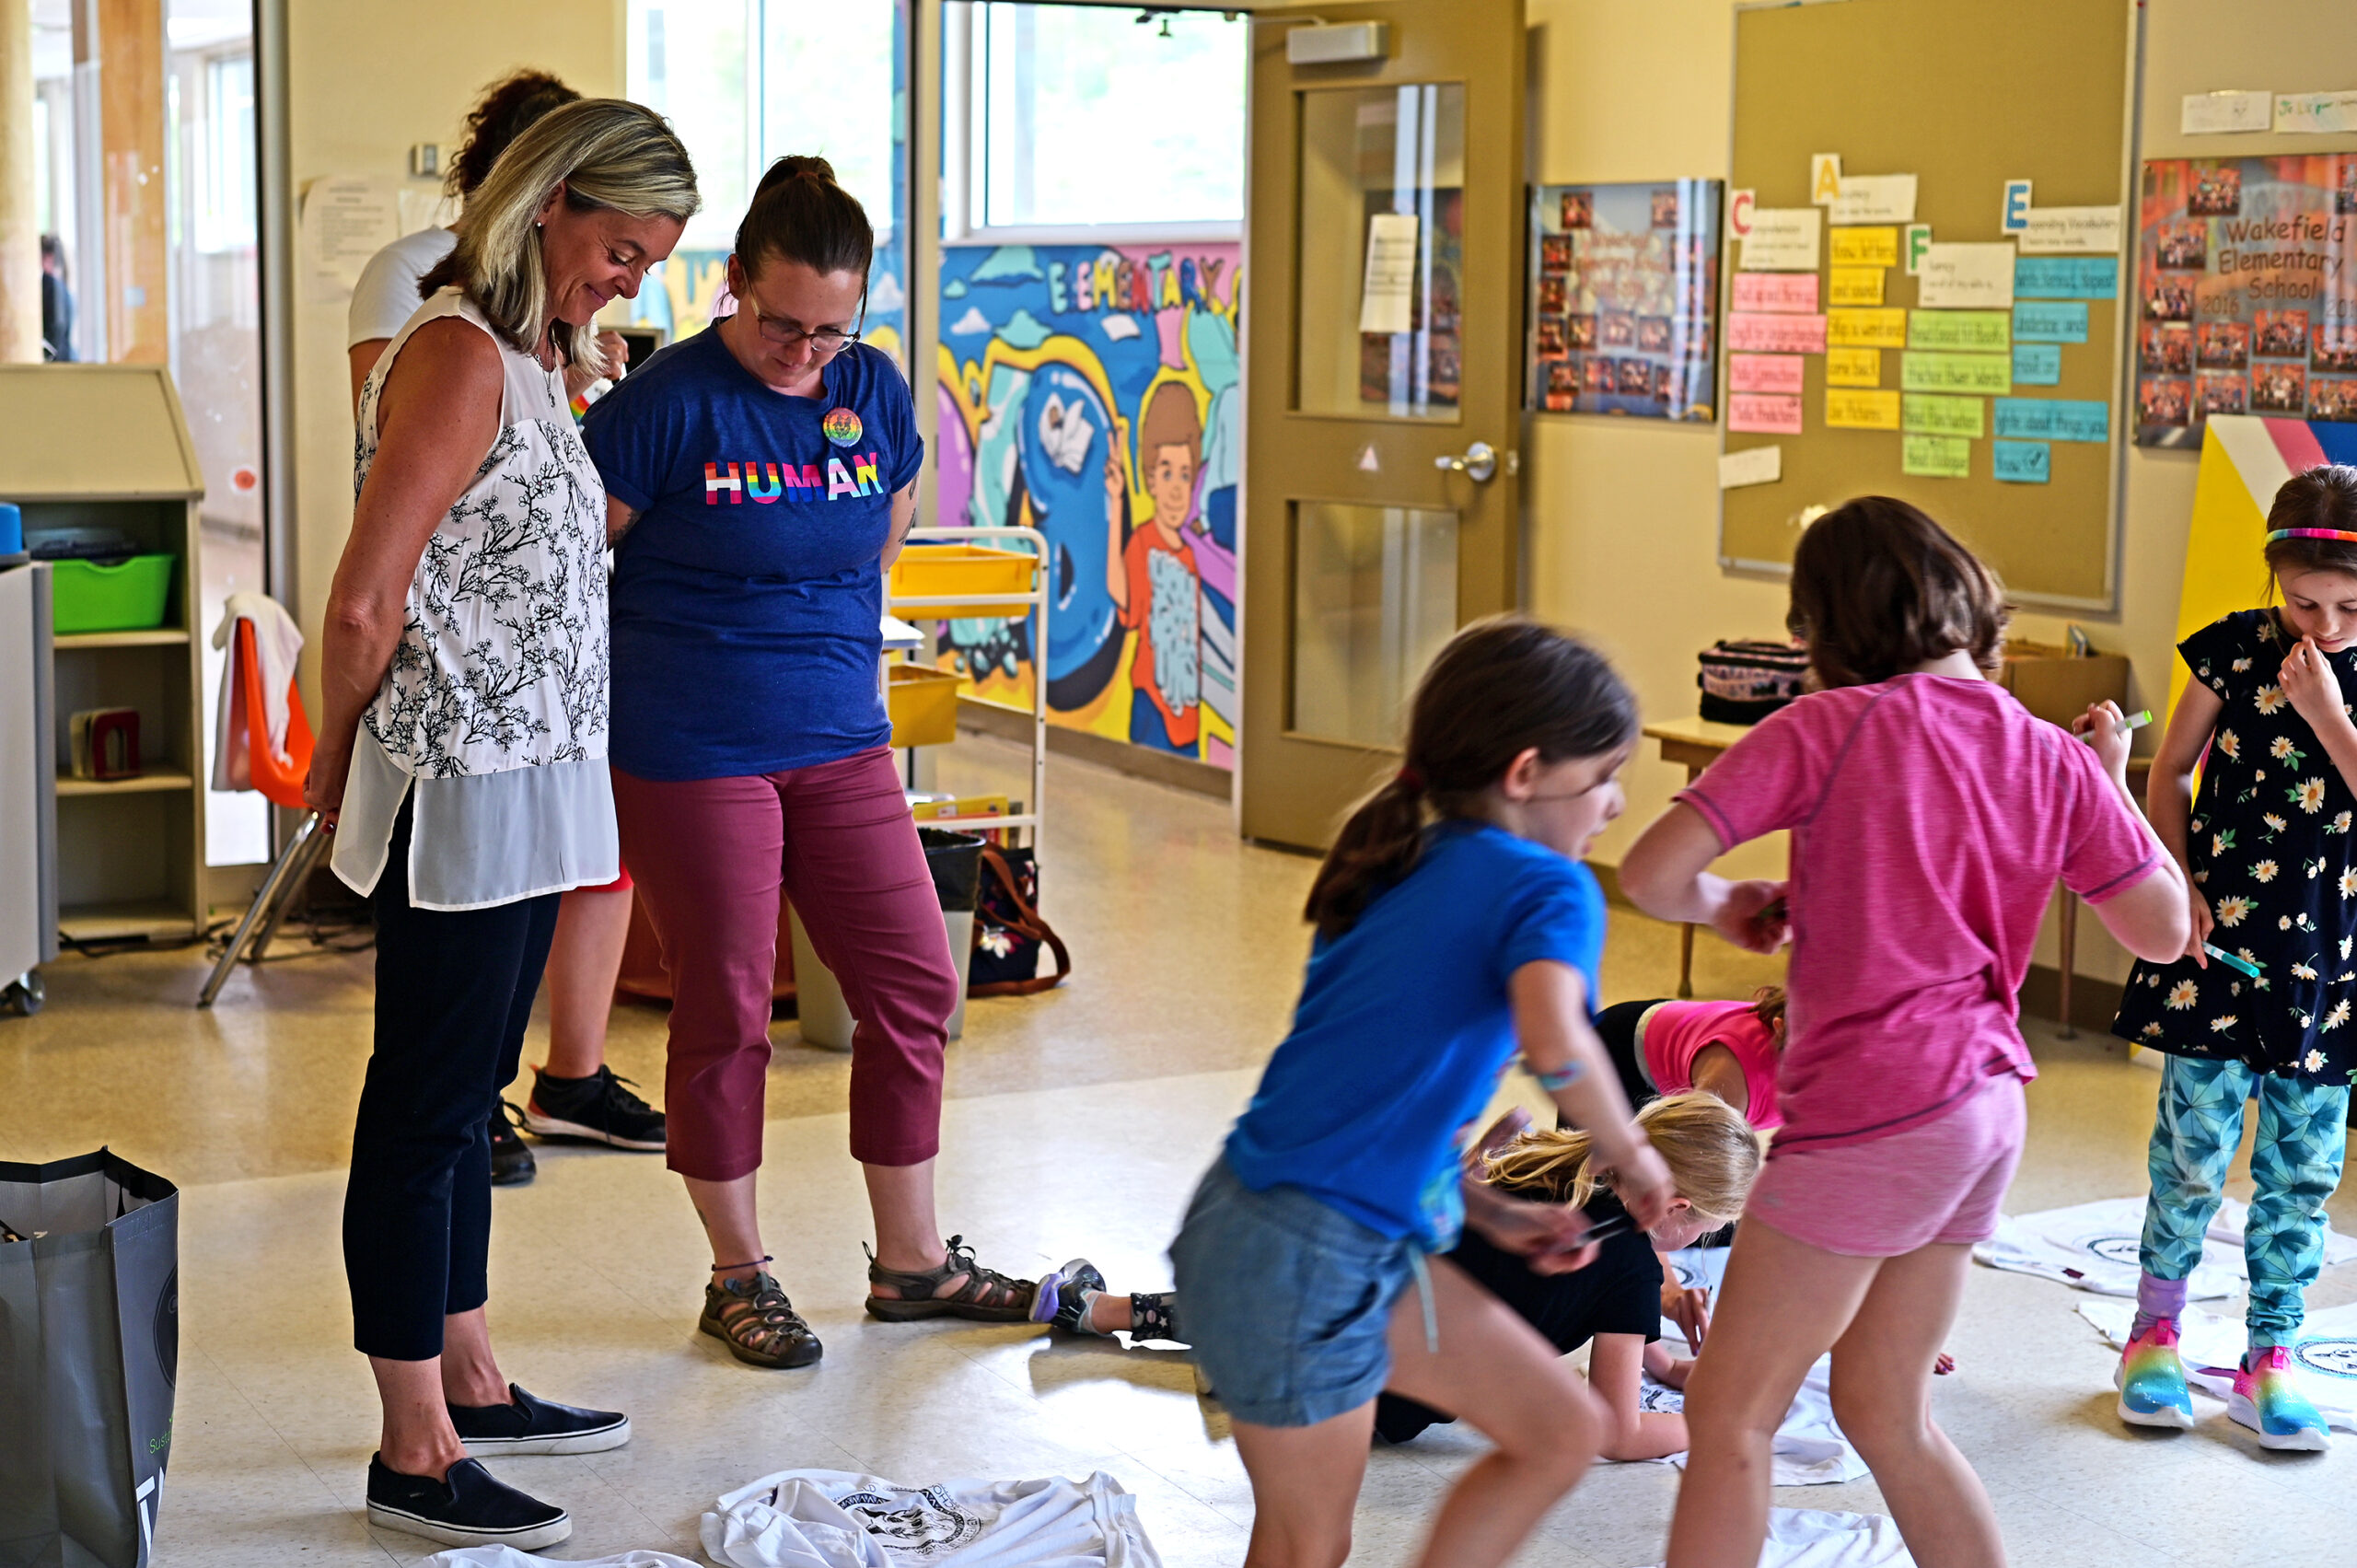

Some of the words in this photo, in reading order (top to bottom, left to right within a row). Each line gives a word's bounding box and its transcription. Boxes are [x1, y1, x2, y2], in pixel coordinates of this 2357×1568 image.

[1816, 158, 1840, 201] A
[1733, 192, 1752, 235] C
[2006, 184, 2029, 228] E
[1910, 228, 1930, 270] F
[2224, 213, 2347, 244] Wakefield
[2218, 248, 2344, 279] Elementary
[2247, 275, 2318, 301] School
[2325, 298, 2357, 319] 201
[704, 452, 884, 505] HUMAN
